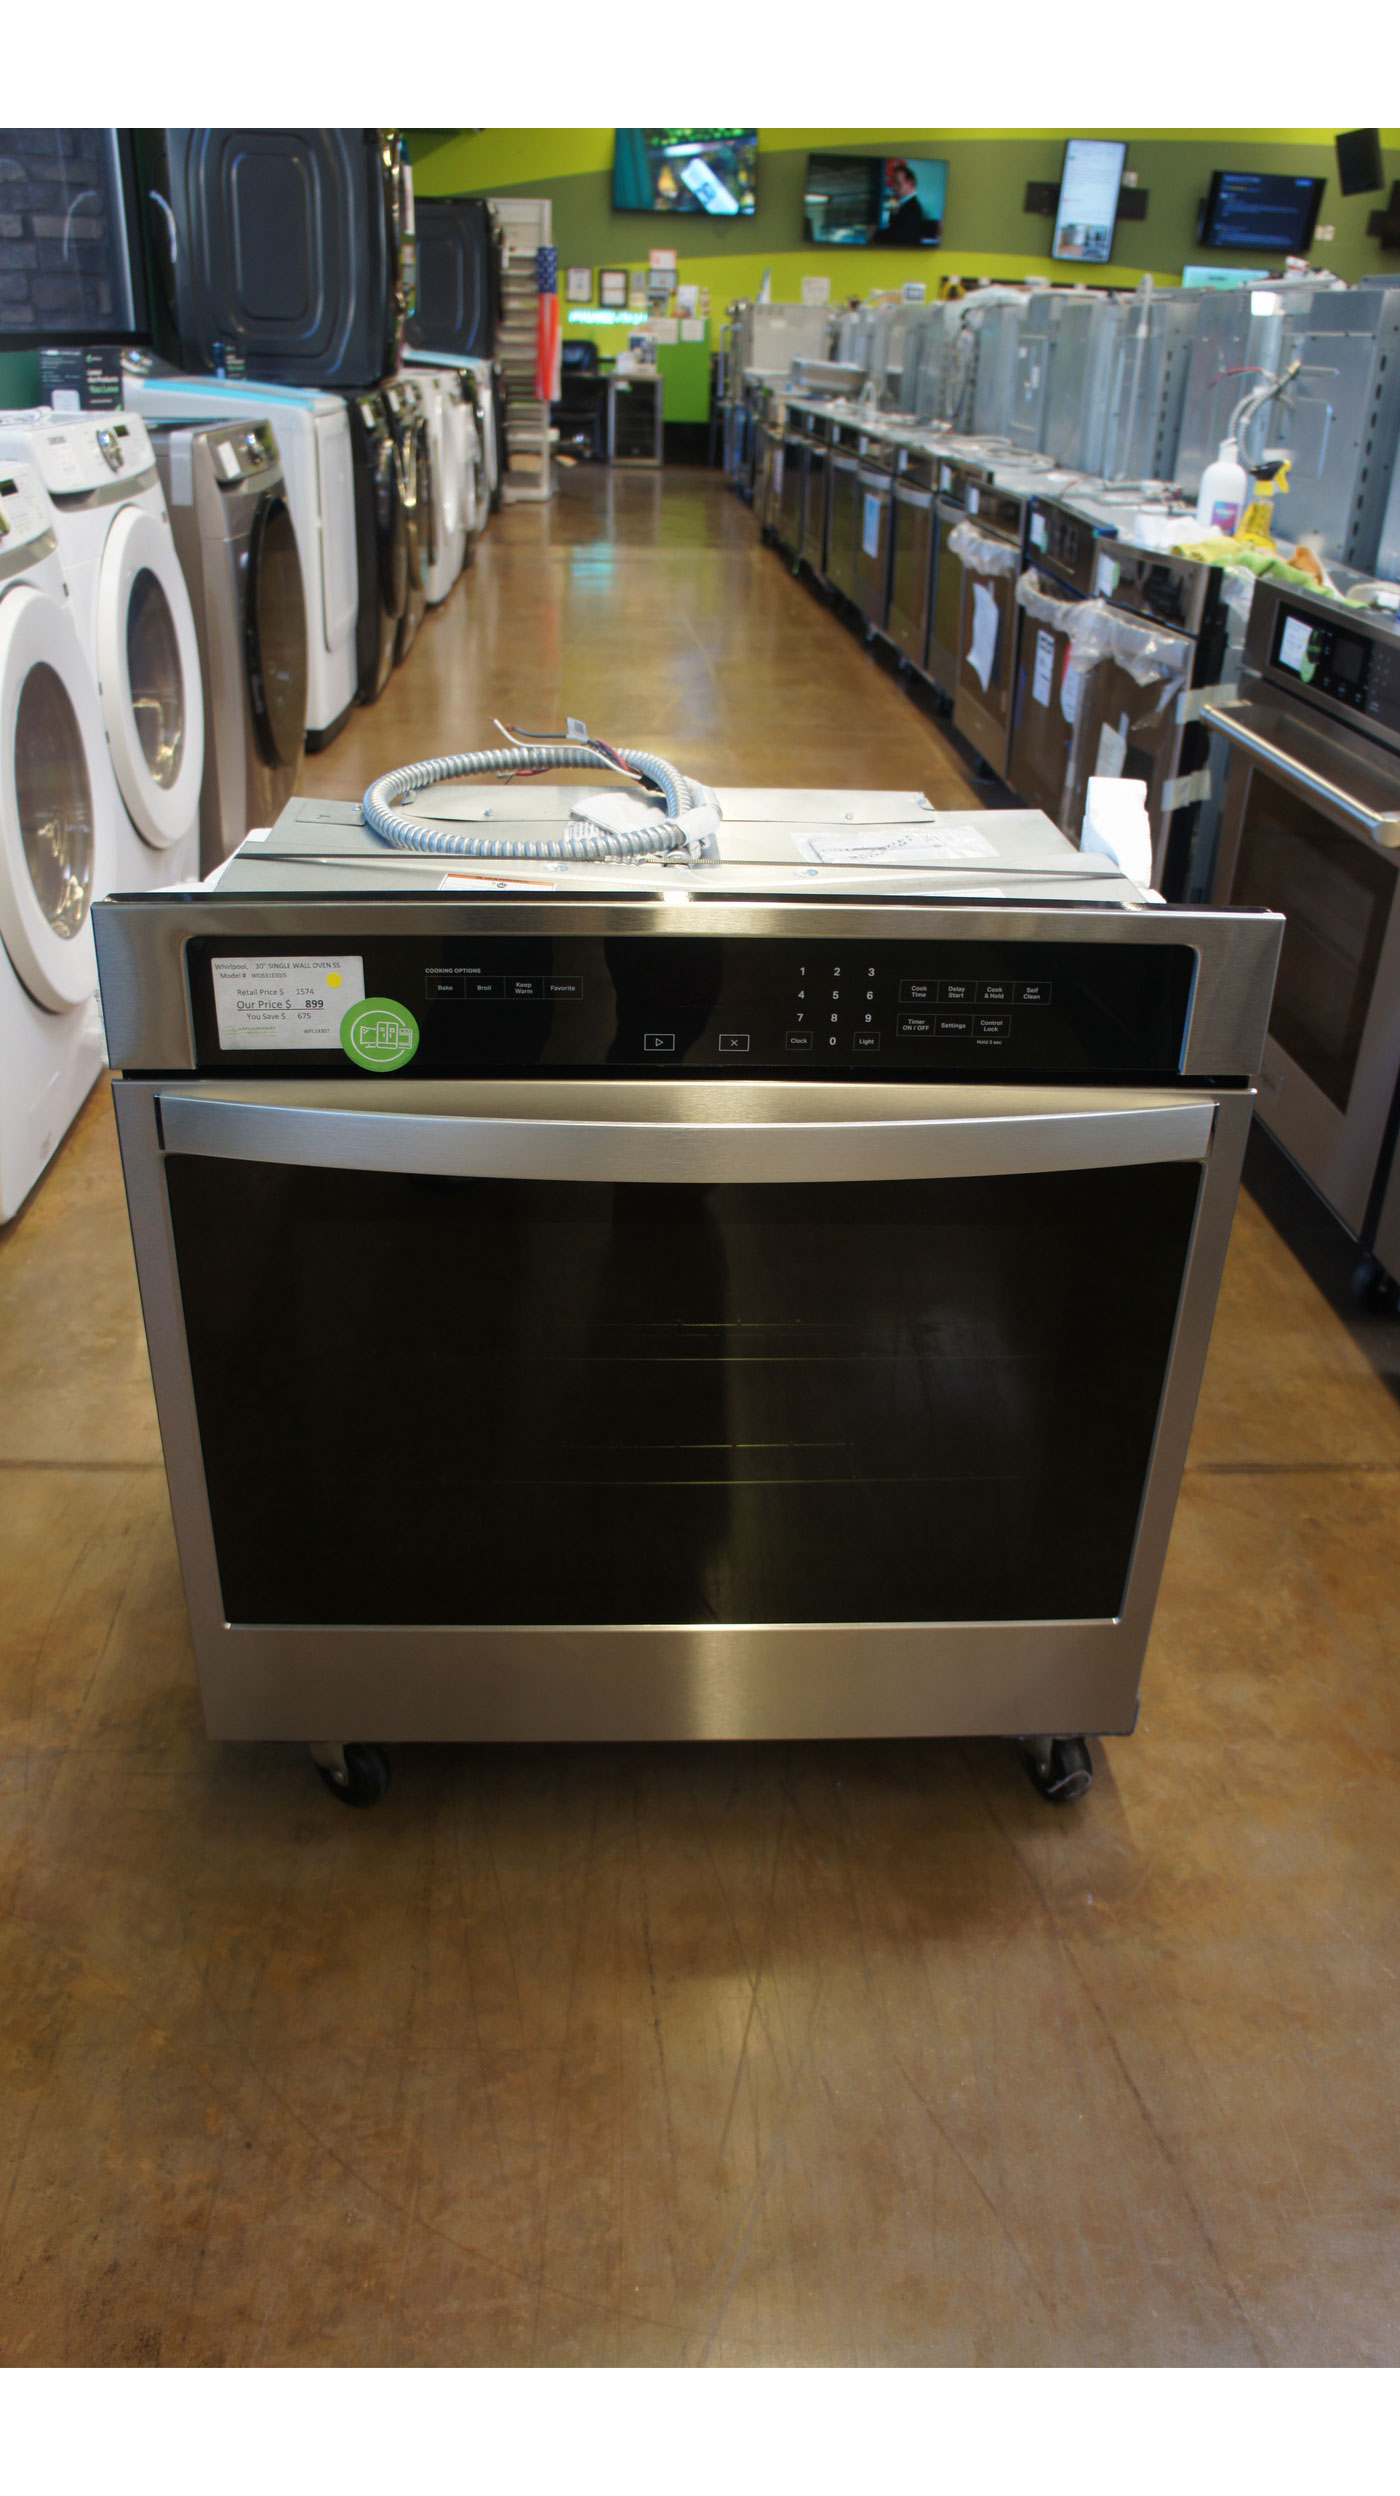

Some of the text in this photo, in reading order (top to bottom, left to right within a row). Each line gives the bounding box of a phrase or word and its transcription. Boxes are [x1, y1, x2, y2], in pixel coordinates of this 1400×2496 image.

[800, 967, 875, 976] 1 2 3
[280, 988, 284, 996] $
[798, 990, 874, 1000] 4 5 6
[236, 1000, 324, 1010] Our Price $ 899
[797, 1013, 872, 1022] 7 8 9
[830, 1037, 836, 1046] 0
